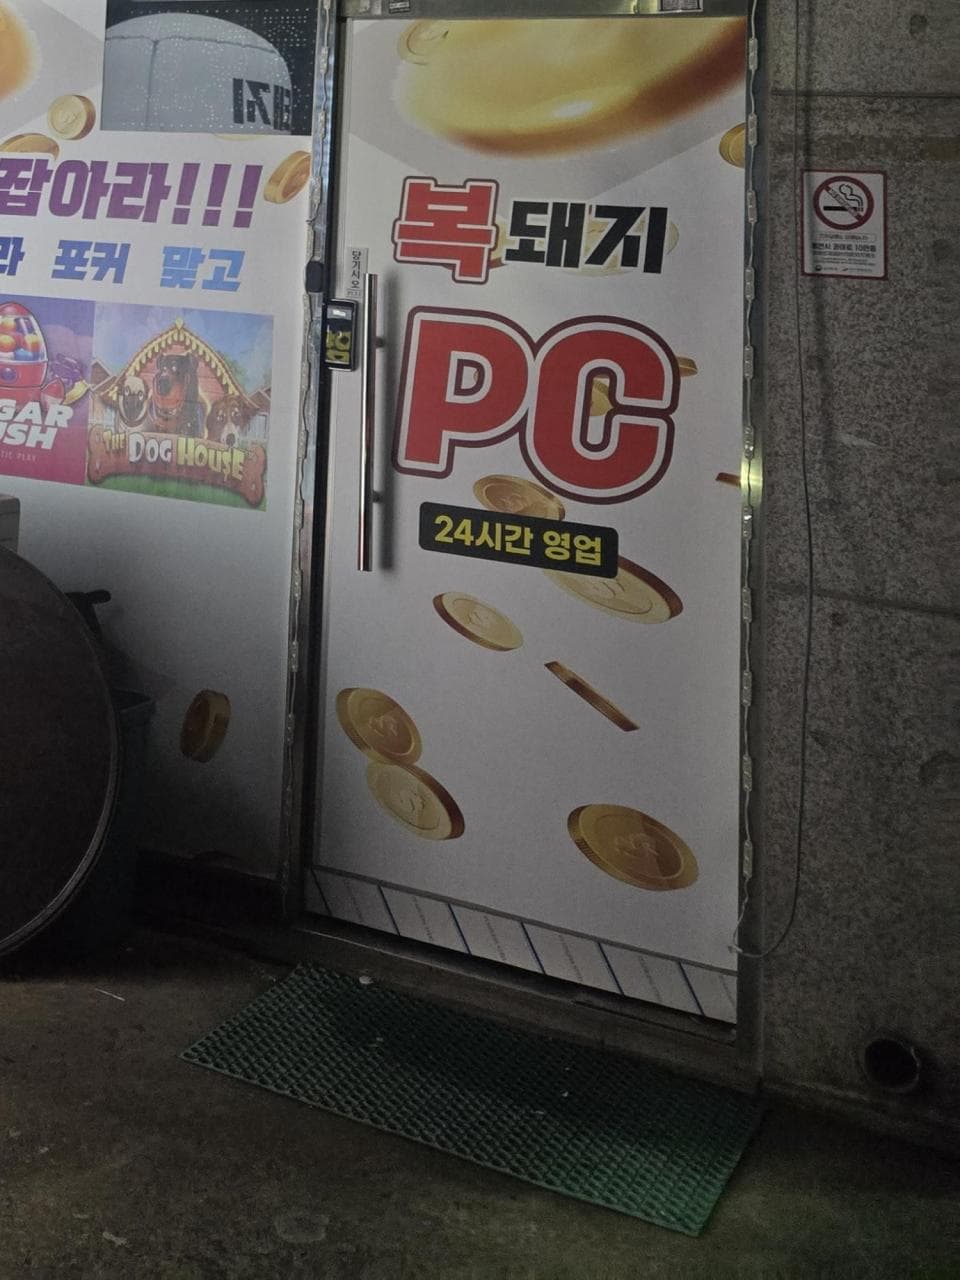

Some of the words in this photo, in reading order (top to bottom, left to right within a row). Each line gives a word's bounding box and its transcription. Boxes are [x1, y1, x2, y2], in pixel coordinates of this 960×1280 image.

[51, 239, 131, 284] 포커
[159, 245, 246, 291] 맞고
[351, 250, 361, 289] 당기시오
[393, 306, 680, 505] PC
[16, 453, 37, 463] PLAY
[102, 429, 126, 453] THE
[128, 431, 173, 464] DOG
[177, 437, 246, 481] HOUSE
[434, 515, 534, 556] 24시간
[543, 531, 601, 566] 영업
